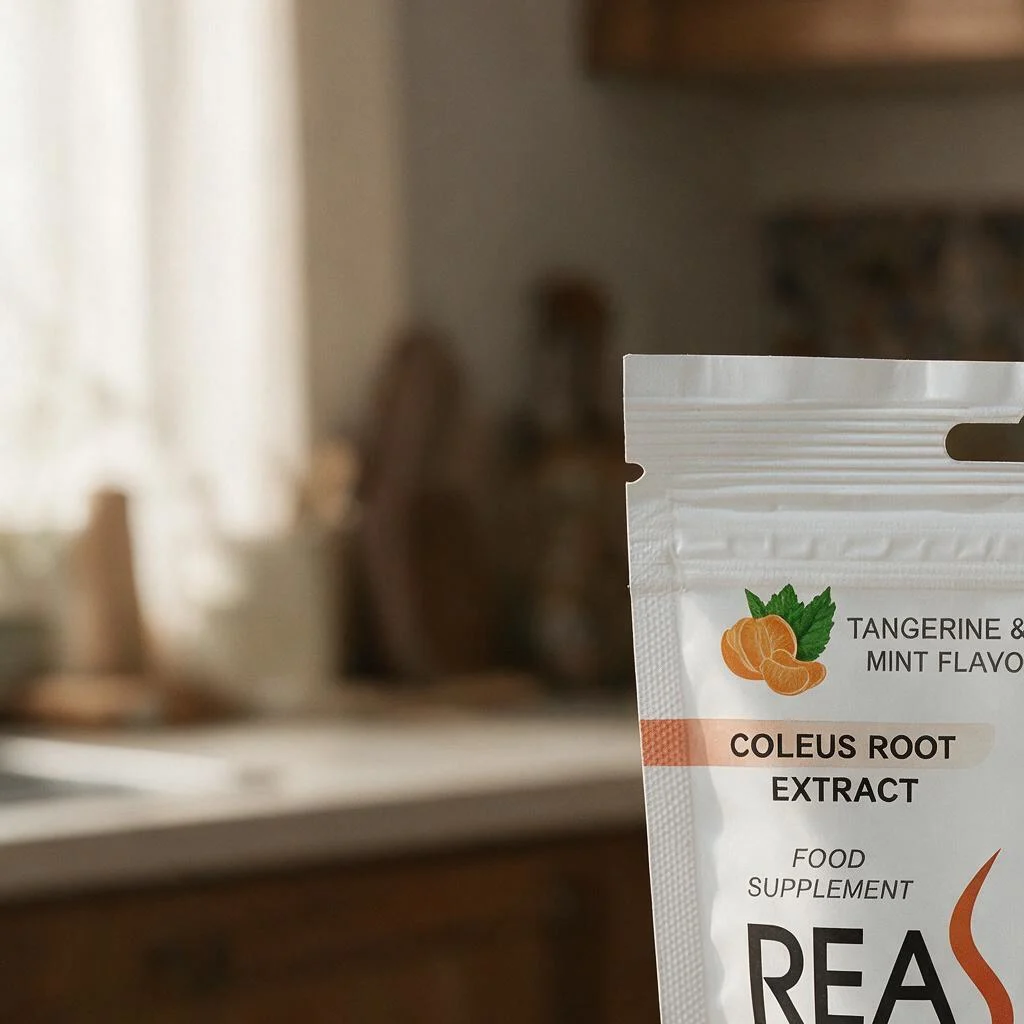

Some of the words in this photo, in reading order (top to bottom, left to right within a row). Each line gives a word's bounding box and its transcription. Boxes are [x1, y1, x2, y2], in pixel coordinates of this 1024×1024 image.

[847, 617, 1001, 640] TANGERINE
[867, 650, 928, 673] MINT
[730, 733, 857, 759] COLEUS
[869, 735, 956, 760] ROOT
[772, 776, 919, 803] EXTRACT
[792, 848, 866, 869] FOOD
[748, 876, 914, 900] SUPPLEMENT
